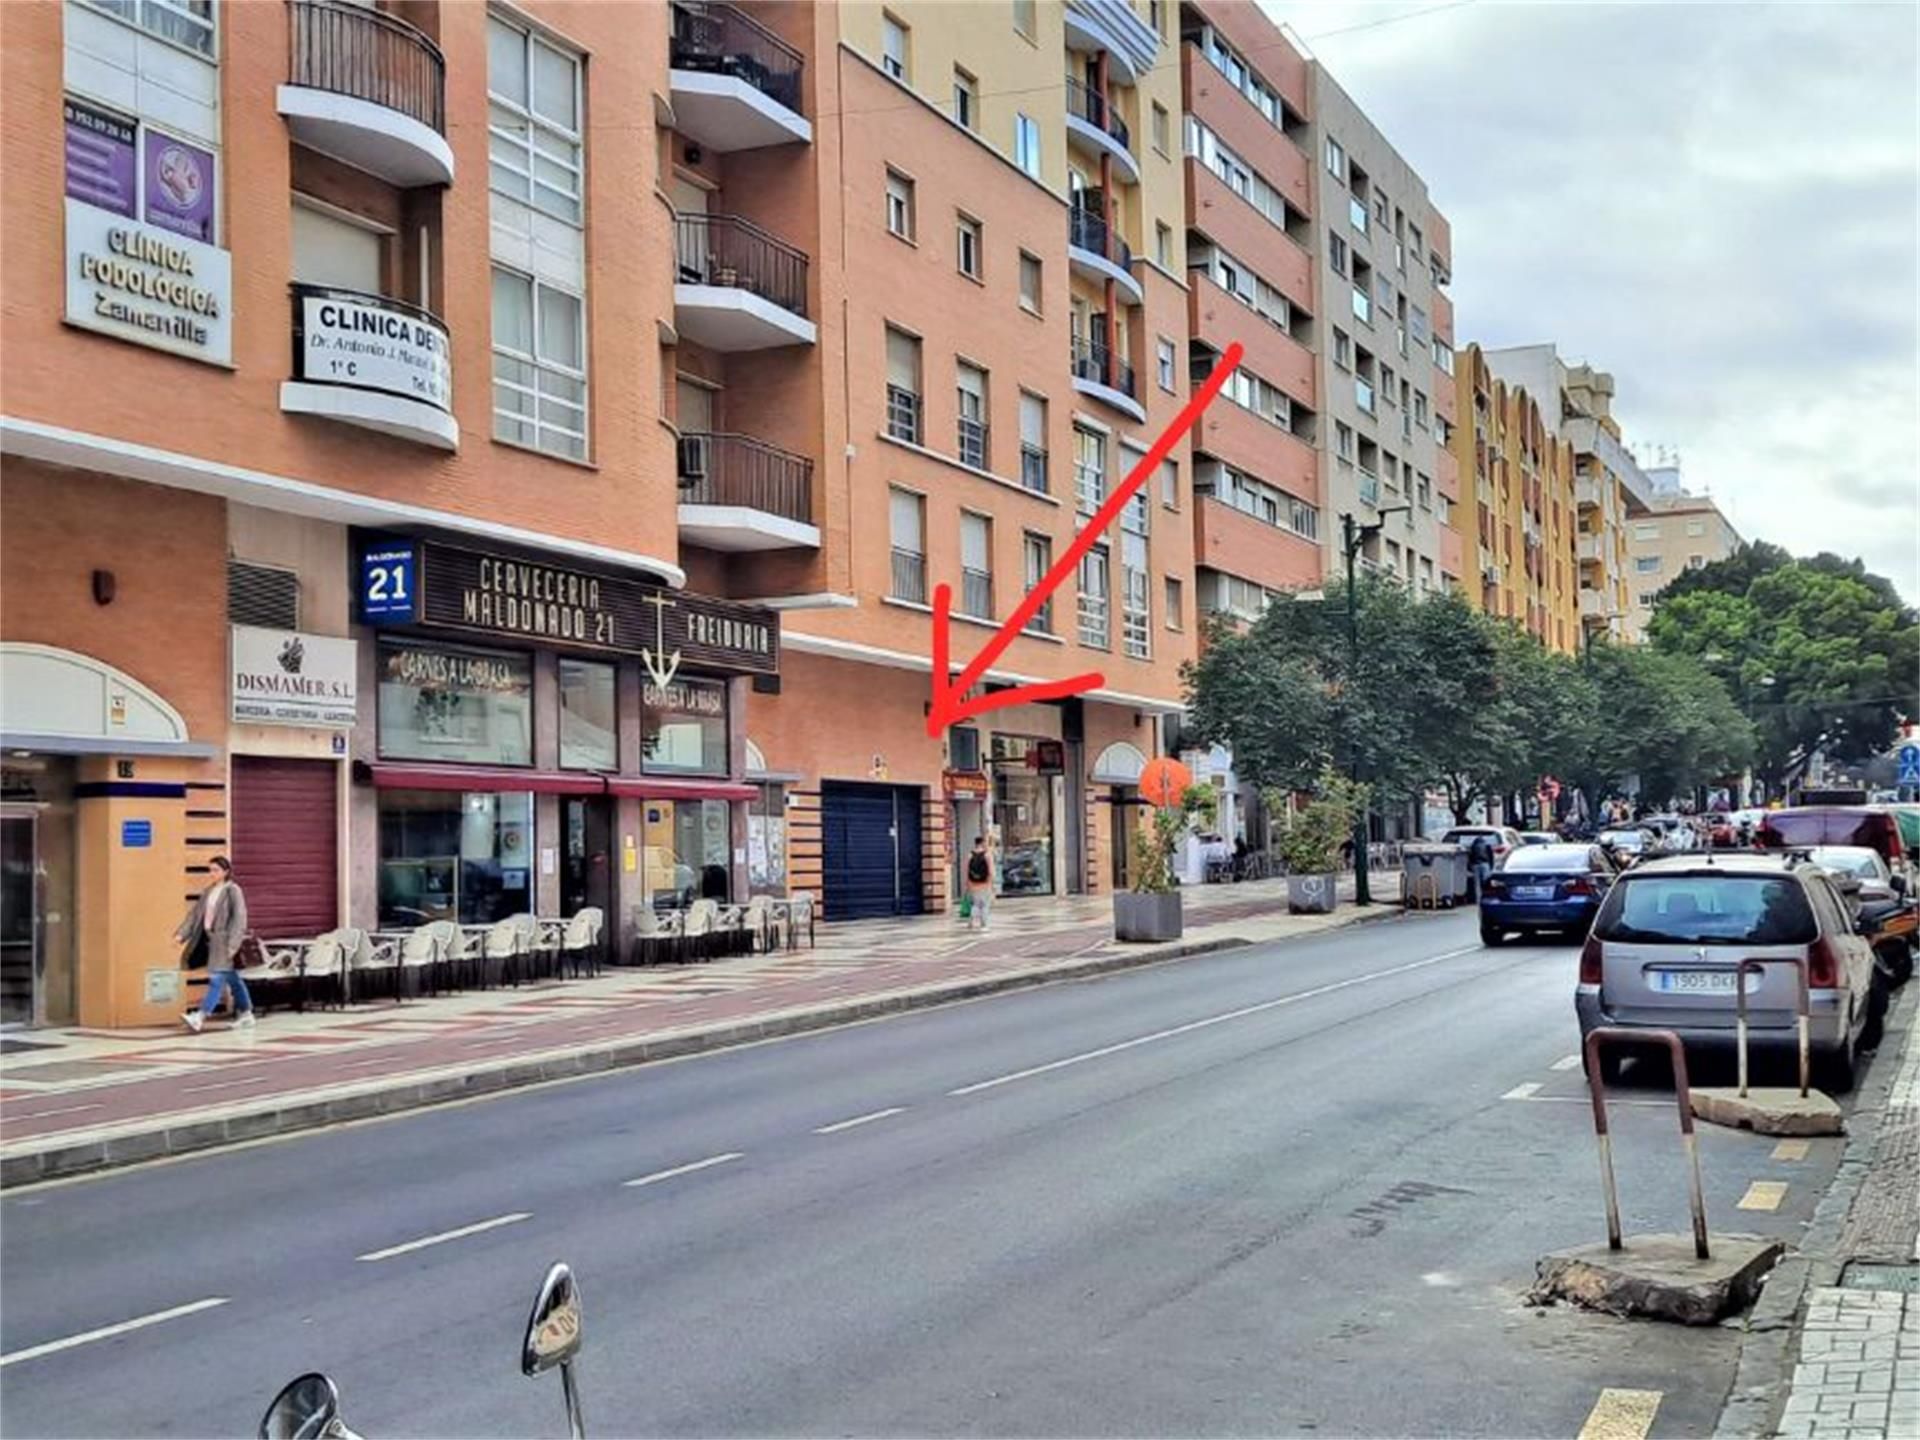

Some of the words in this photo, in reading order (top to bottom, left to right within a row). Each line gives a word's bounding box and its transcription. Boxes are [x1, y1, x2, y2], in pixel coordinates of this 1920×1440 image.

[319, 305, 411, 343] CLINICA
[310, 334, 331, 350] Dr.
[333, 337, 386, 358] Antonio
[347, 361, 357, 377] C
[368, 565, 407, 601] 21
[480, 558, 600, 609] CERVECERIA
[463, 589, 585, 640] MALDONADO
[595, 612, 615, 644] 21
[687, 613, 769, 654] FREIDURIA
[237, 672, 326, 697] DISMAMER
